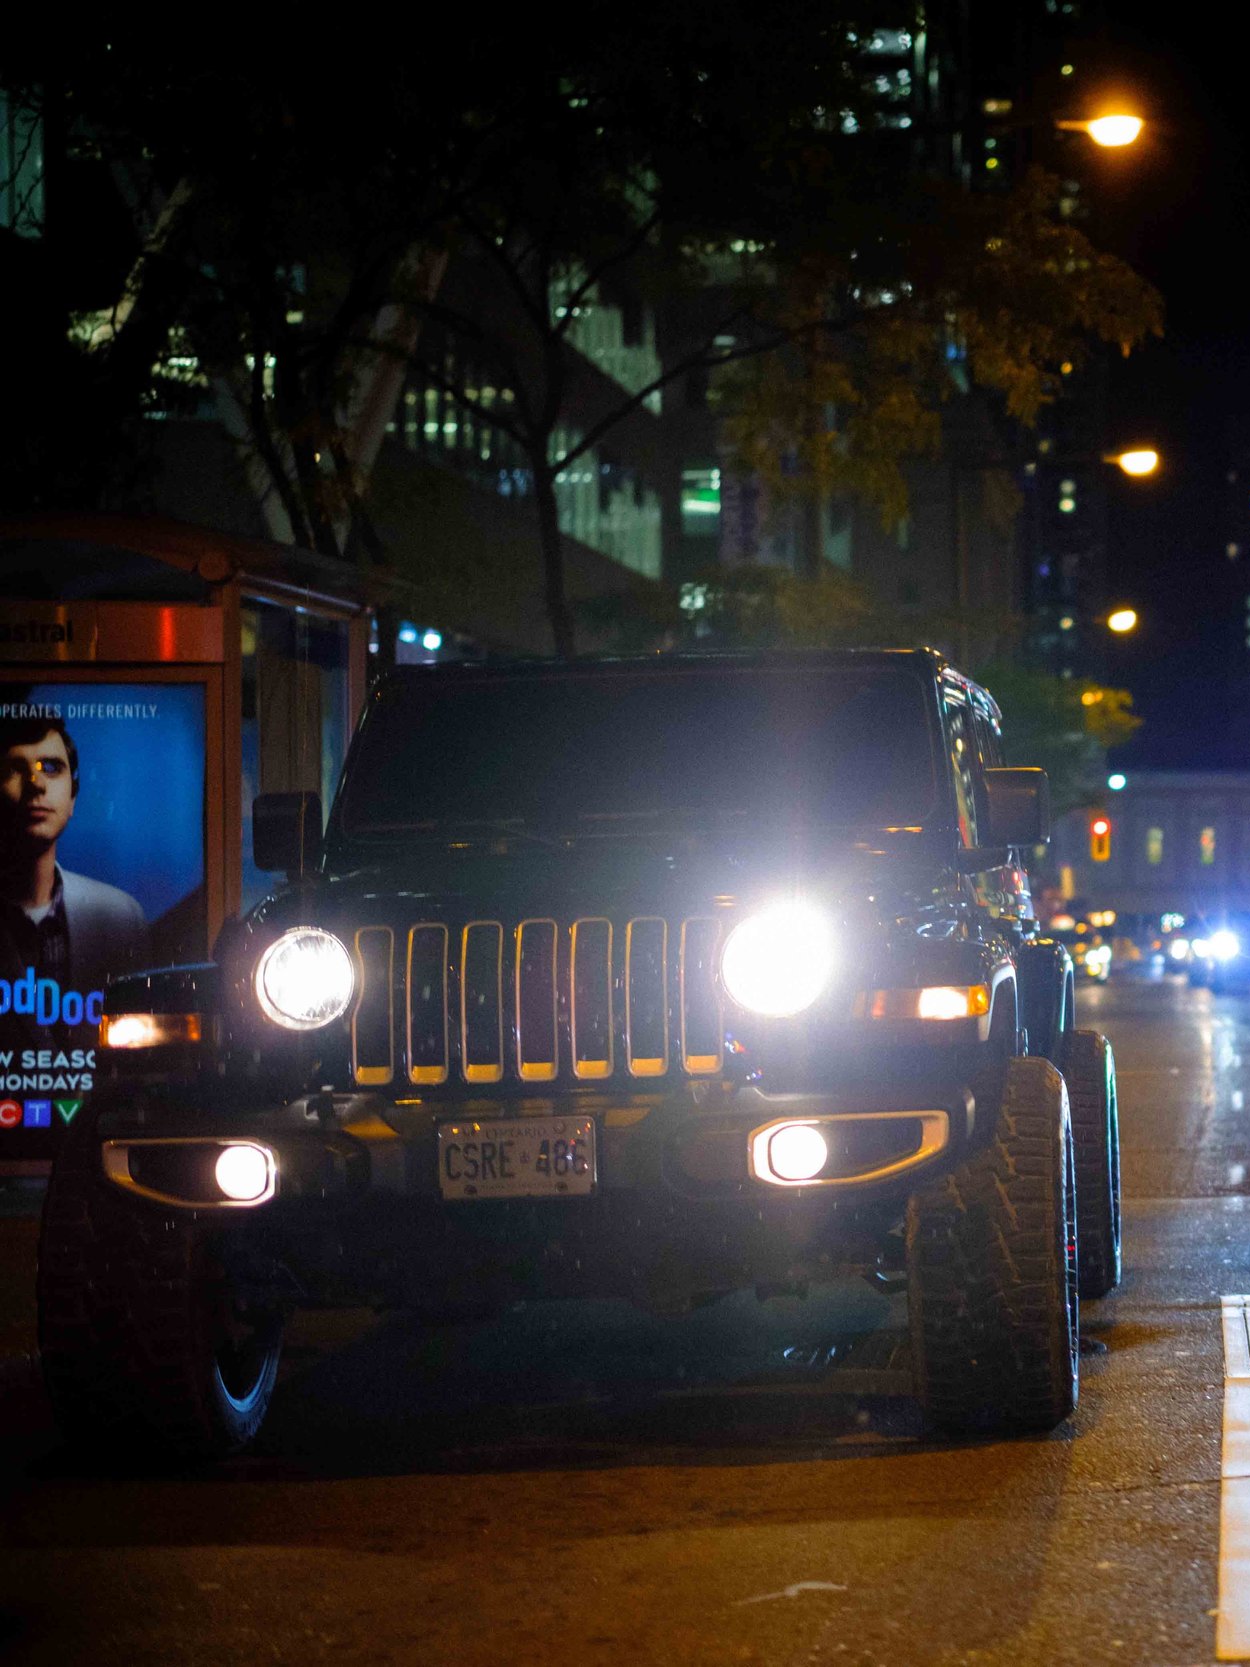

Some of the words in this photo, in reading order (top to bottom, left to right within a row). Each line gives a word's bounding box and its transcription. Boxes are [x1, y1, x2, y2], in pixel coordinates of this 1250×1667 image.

[0, 1074, 94, 1092] ONDAYS
[445, 1142, 515, 1180] CSRE
[535, 1138, 587, 1176] 486
